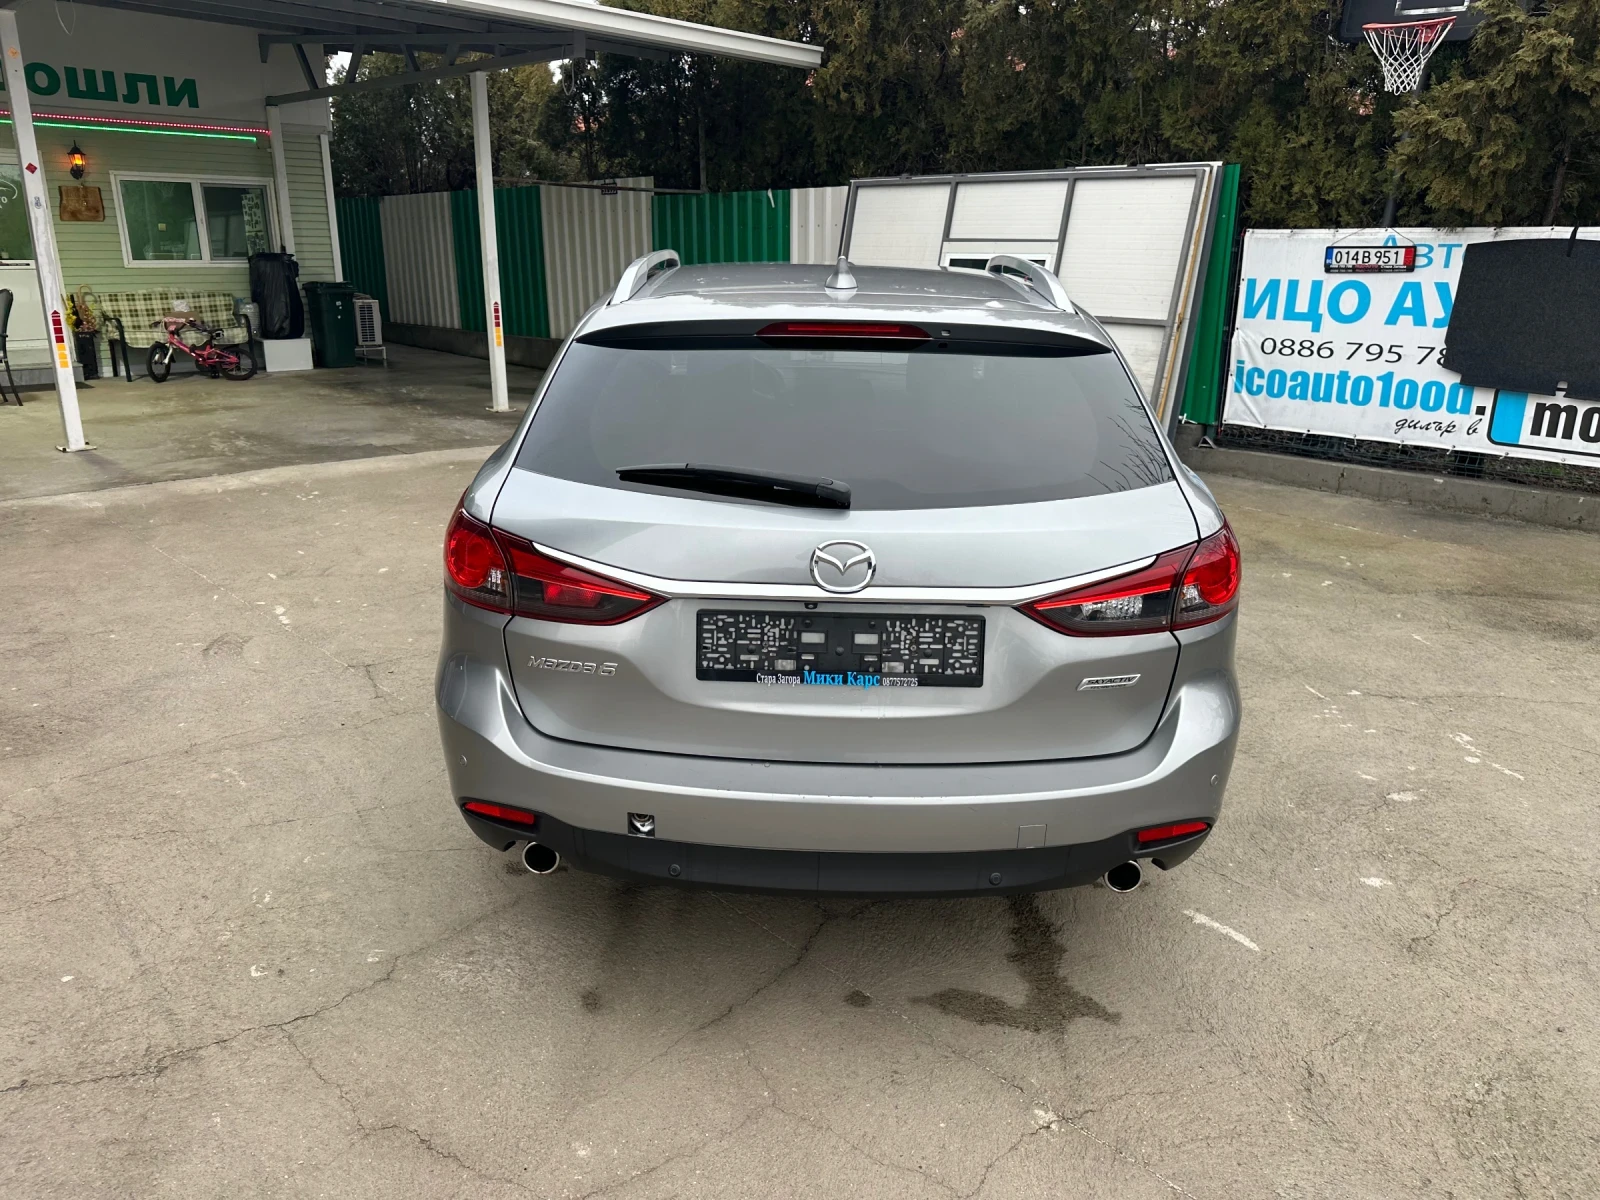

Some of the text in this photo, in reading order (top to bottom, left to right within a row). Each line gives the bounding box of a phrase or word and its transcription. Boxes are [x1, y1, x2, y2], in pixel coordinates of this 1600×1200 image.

[0, 58, 200, 109] ОШЛИ
[1243, 278, 1372, 333] ИЦО
[1260, 337, 1335, 360] 0886
[1345, 341, 1403, 364] 795
[1530, 402, 1600, 443] mo
[599, 662, 619, 677] 6
[756, 672, 776, 686] Стара
[777, 674, 801, 687] Загора
[803, 670, 844, 686] Мики
[846, 671, 881, 690] Карс
